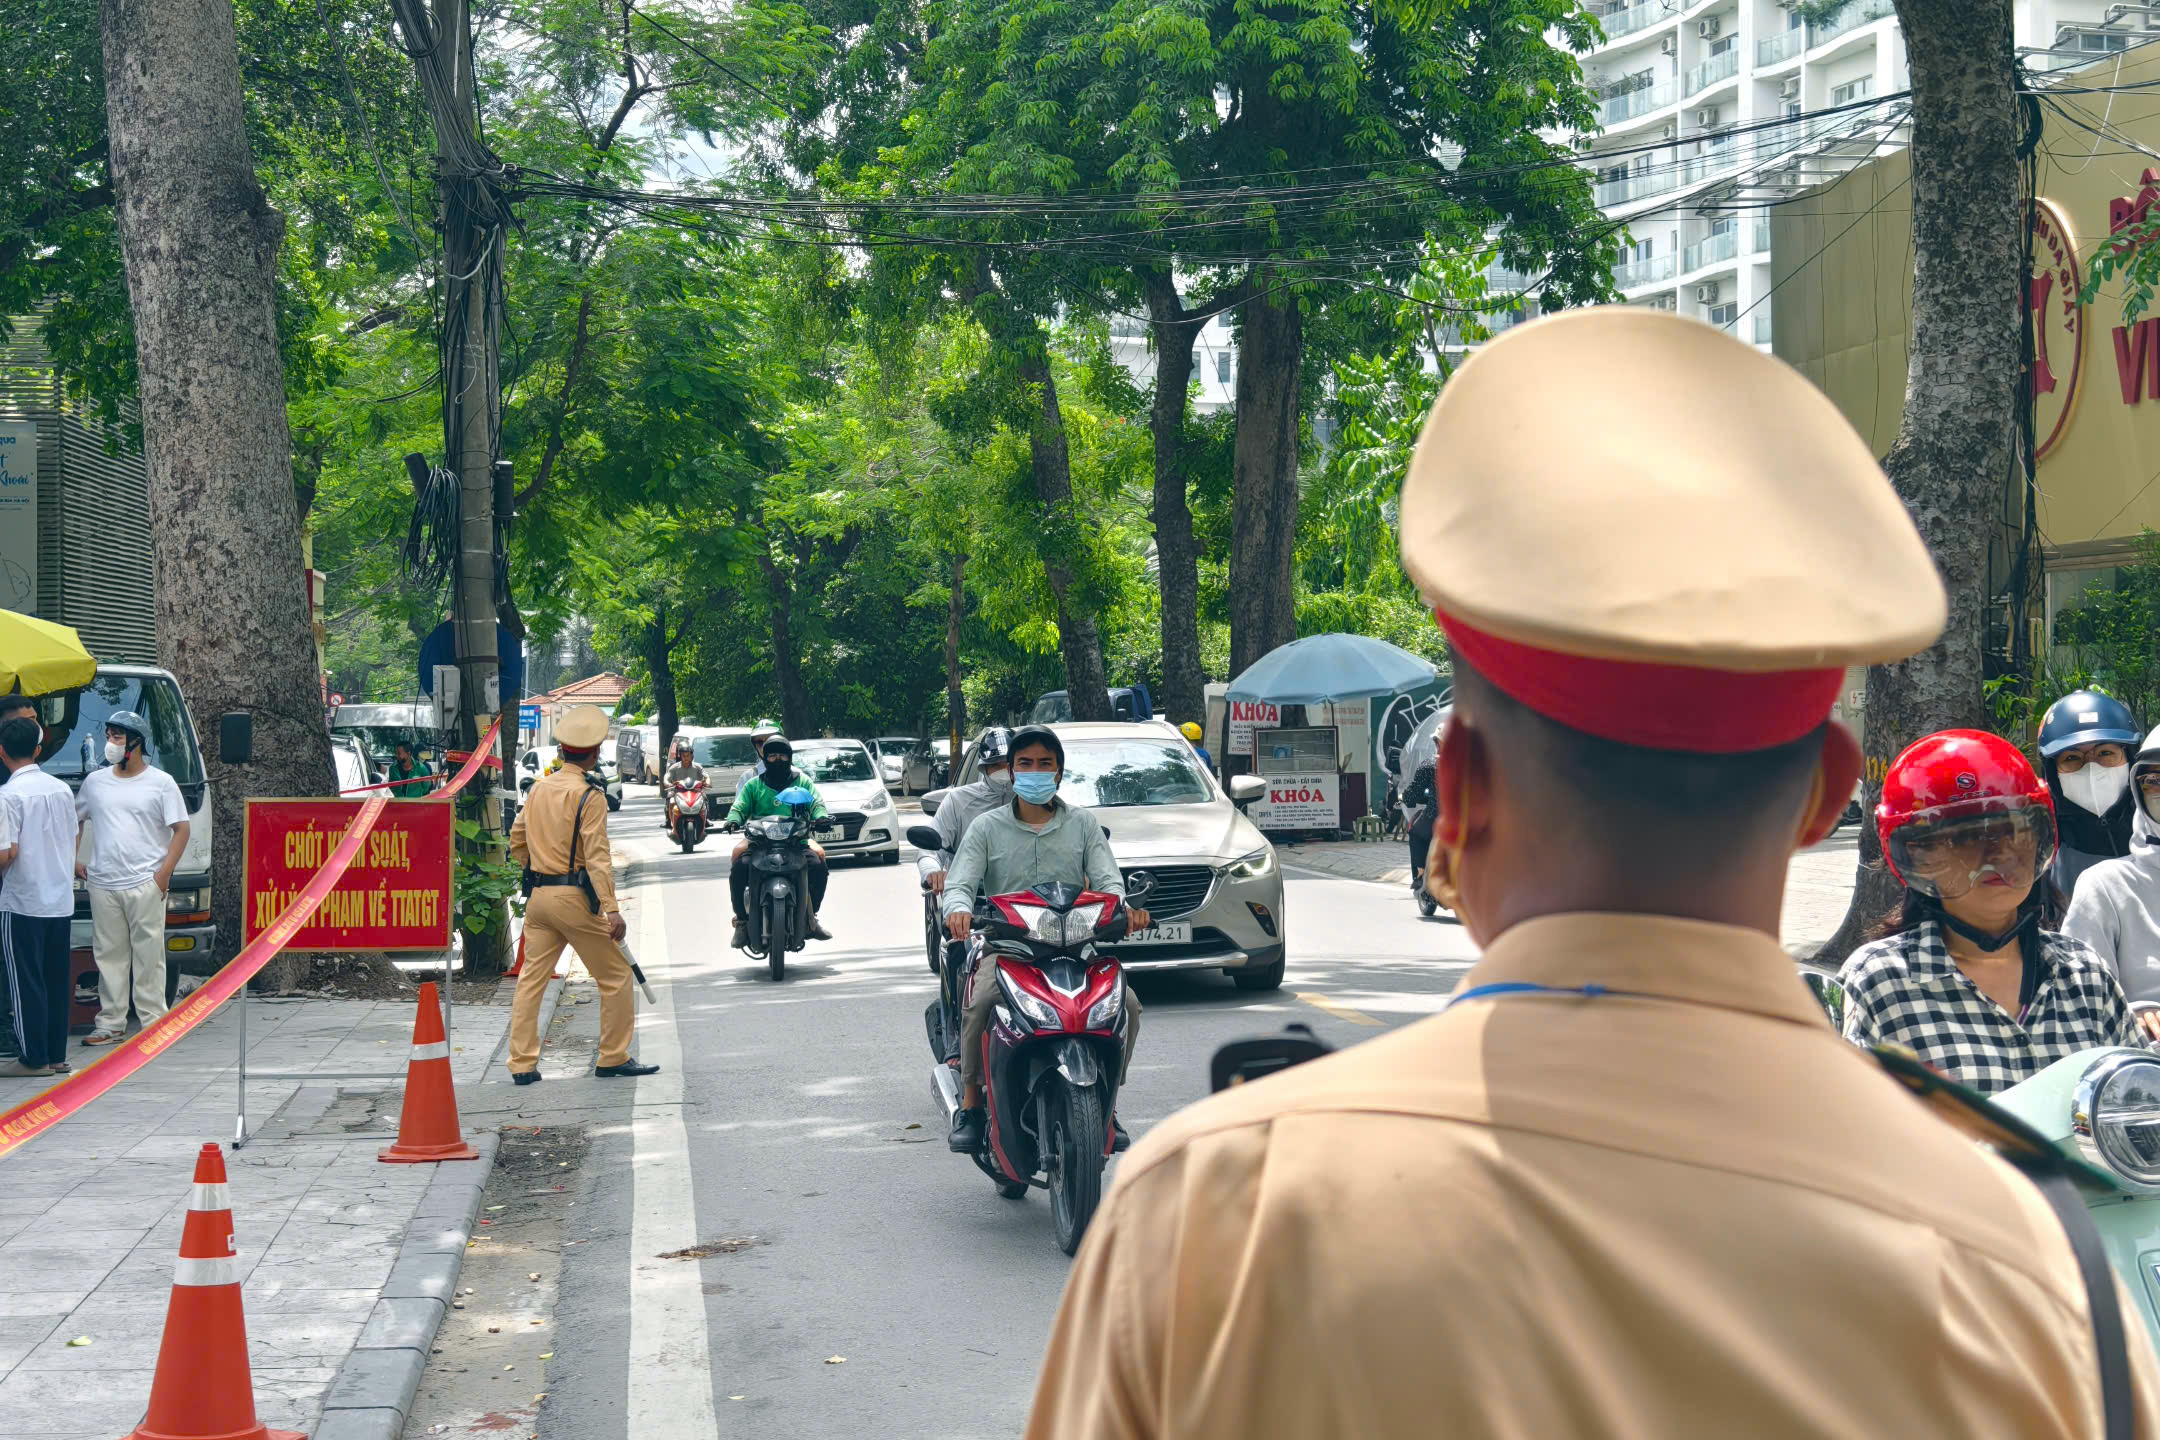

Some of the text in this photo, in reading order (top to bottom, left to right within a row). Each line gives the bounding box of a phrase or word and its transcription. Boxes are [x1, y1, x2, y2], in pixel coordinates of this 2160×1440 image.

[1270, 785, 1325, 803] KHÓA
[285, 817, 324, 869] CHỐT
[320, 890, 364, 937] PHẠM
[368, 877, 388, 928] VỀ
[391, 889, 440, 928] TTATGT
